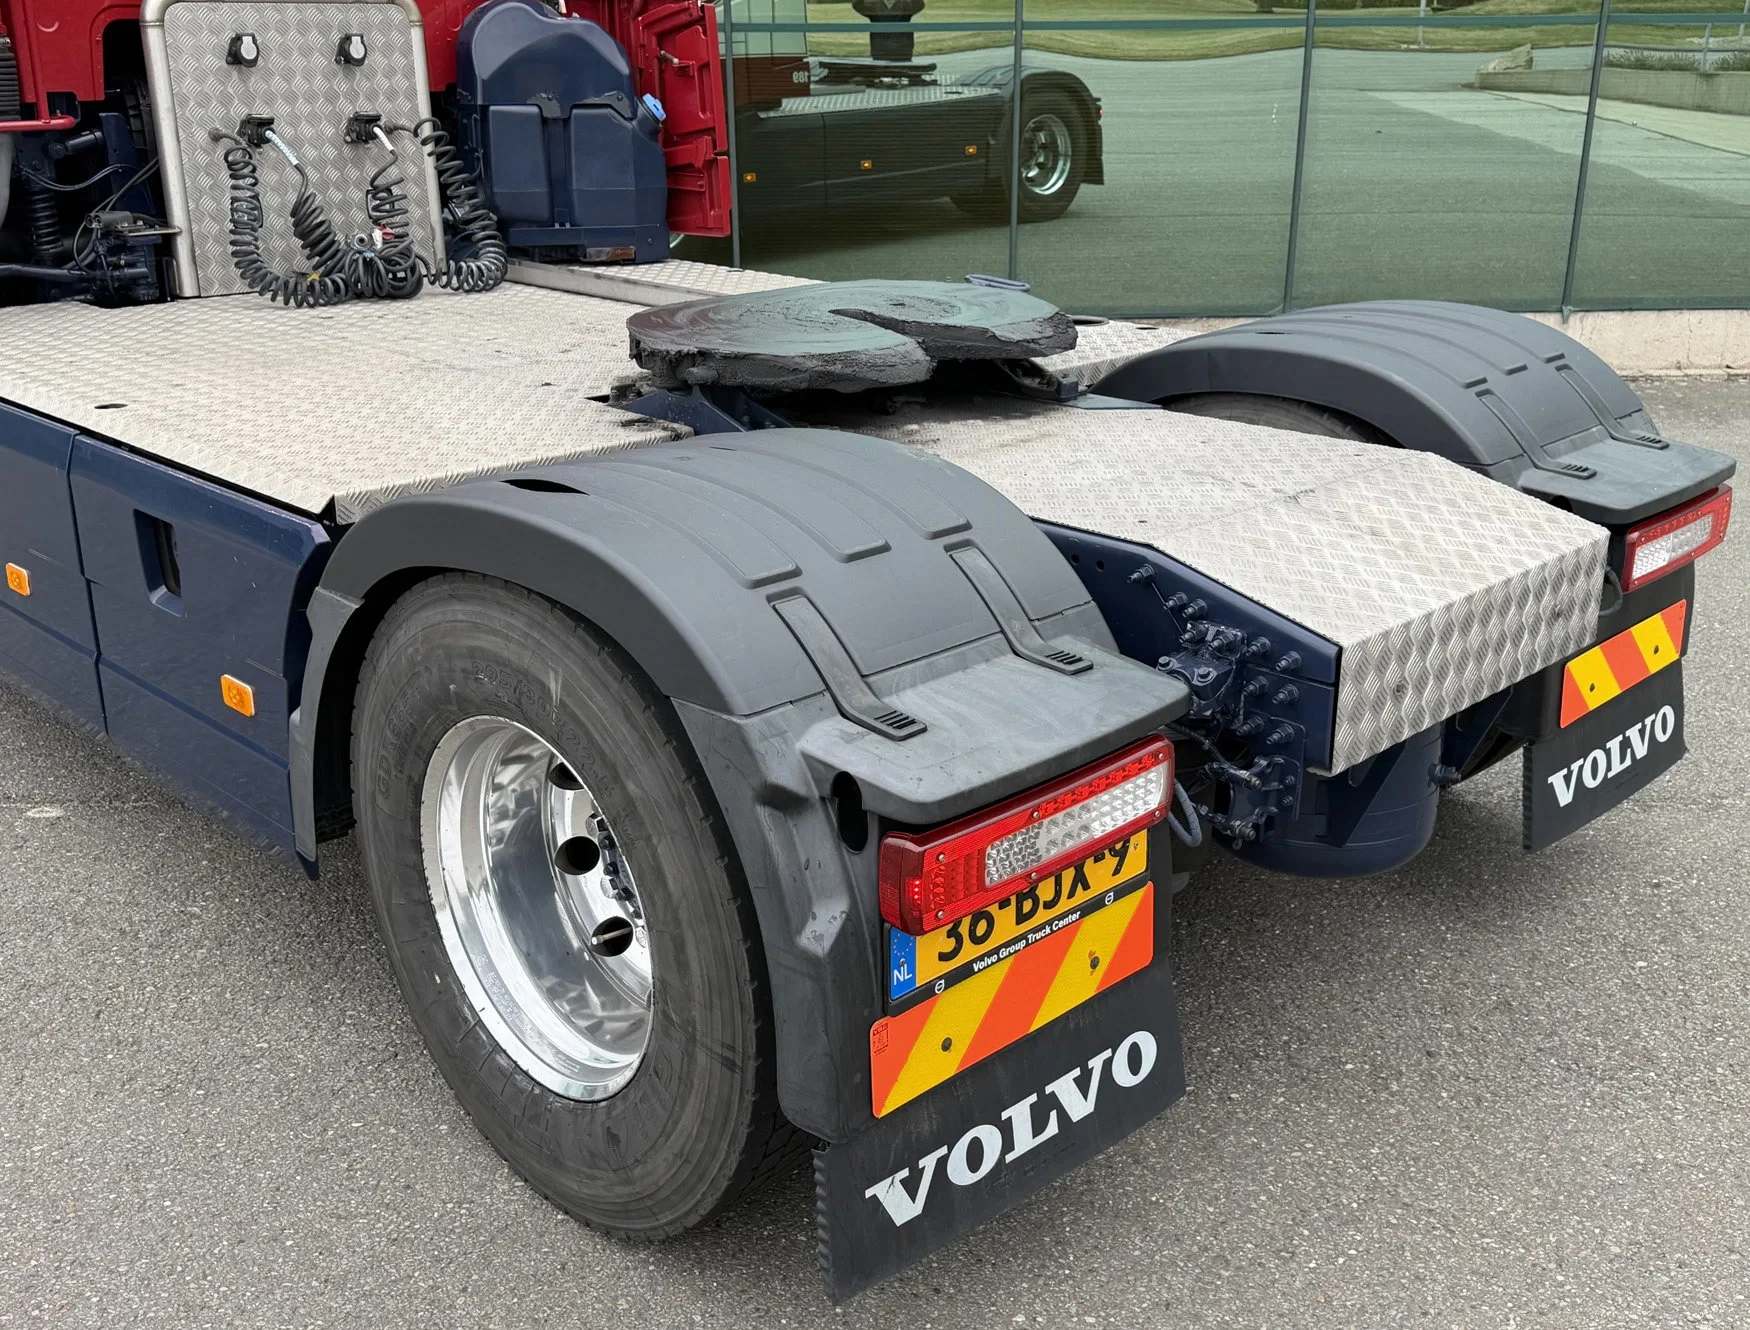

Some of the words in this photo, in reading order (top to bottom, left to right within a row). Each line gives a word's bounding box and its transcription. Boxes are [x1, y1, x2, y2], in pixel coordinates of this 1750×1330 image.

[1547, 704, 1675, 808] VOLVO
[937, 835, 1132, 962] 36-BJX-9
[972, 954, 998, 972] Volvo
[999, 938, 1026, 959] Group
[1027, 927, 1051, 945] Truck
[1052, 910, 1081, 934] Center
[893, 966, 913, 986] NL
[864, 1030, 1158, 1227] VOLVO
